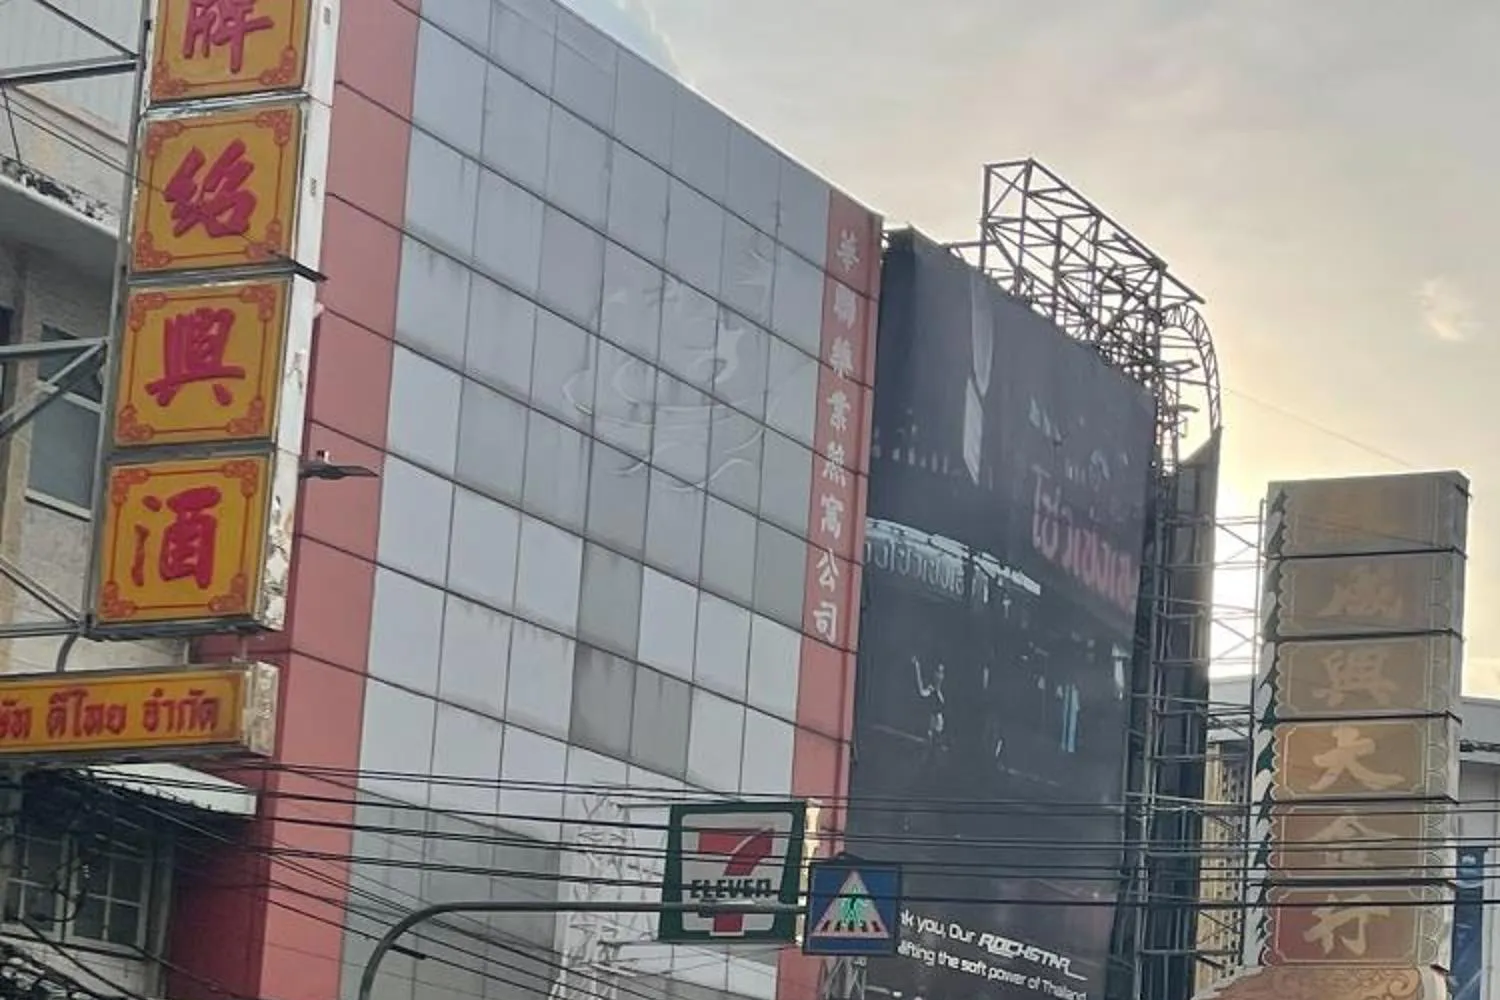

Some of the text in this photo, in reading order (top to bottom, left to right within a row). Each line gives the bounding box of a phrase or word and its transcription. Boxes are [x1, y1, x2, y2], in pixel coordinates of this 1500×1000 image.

[937, 950, 960, 970] the
[960, 957, 988, 978] soft
[987, 966, 1028, 986] power
[1027, 976, 1042, 991] of
